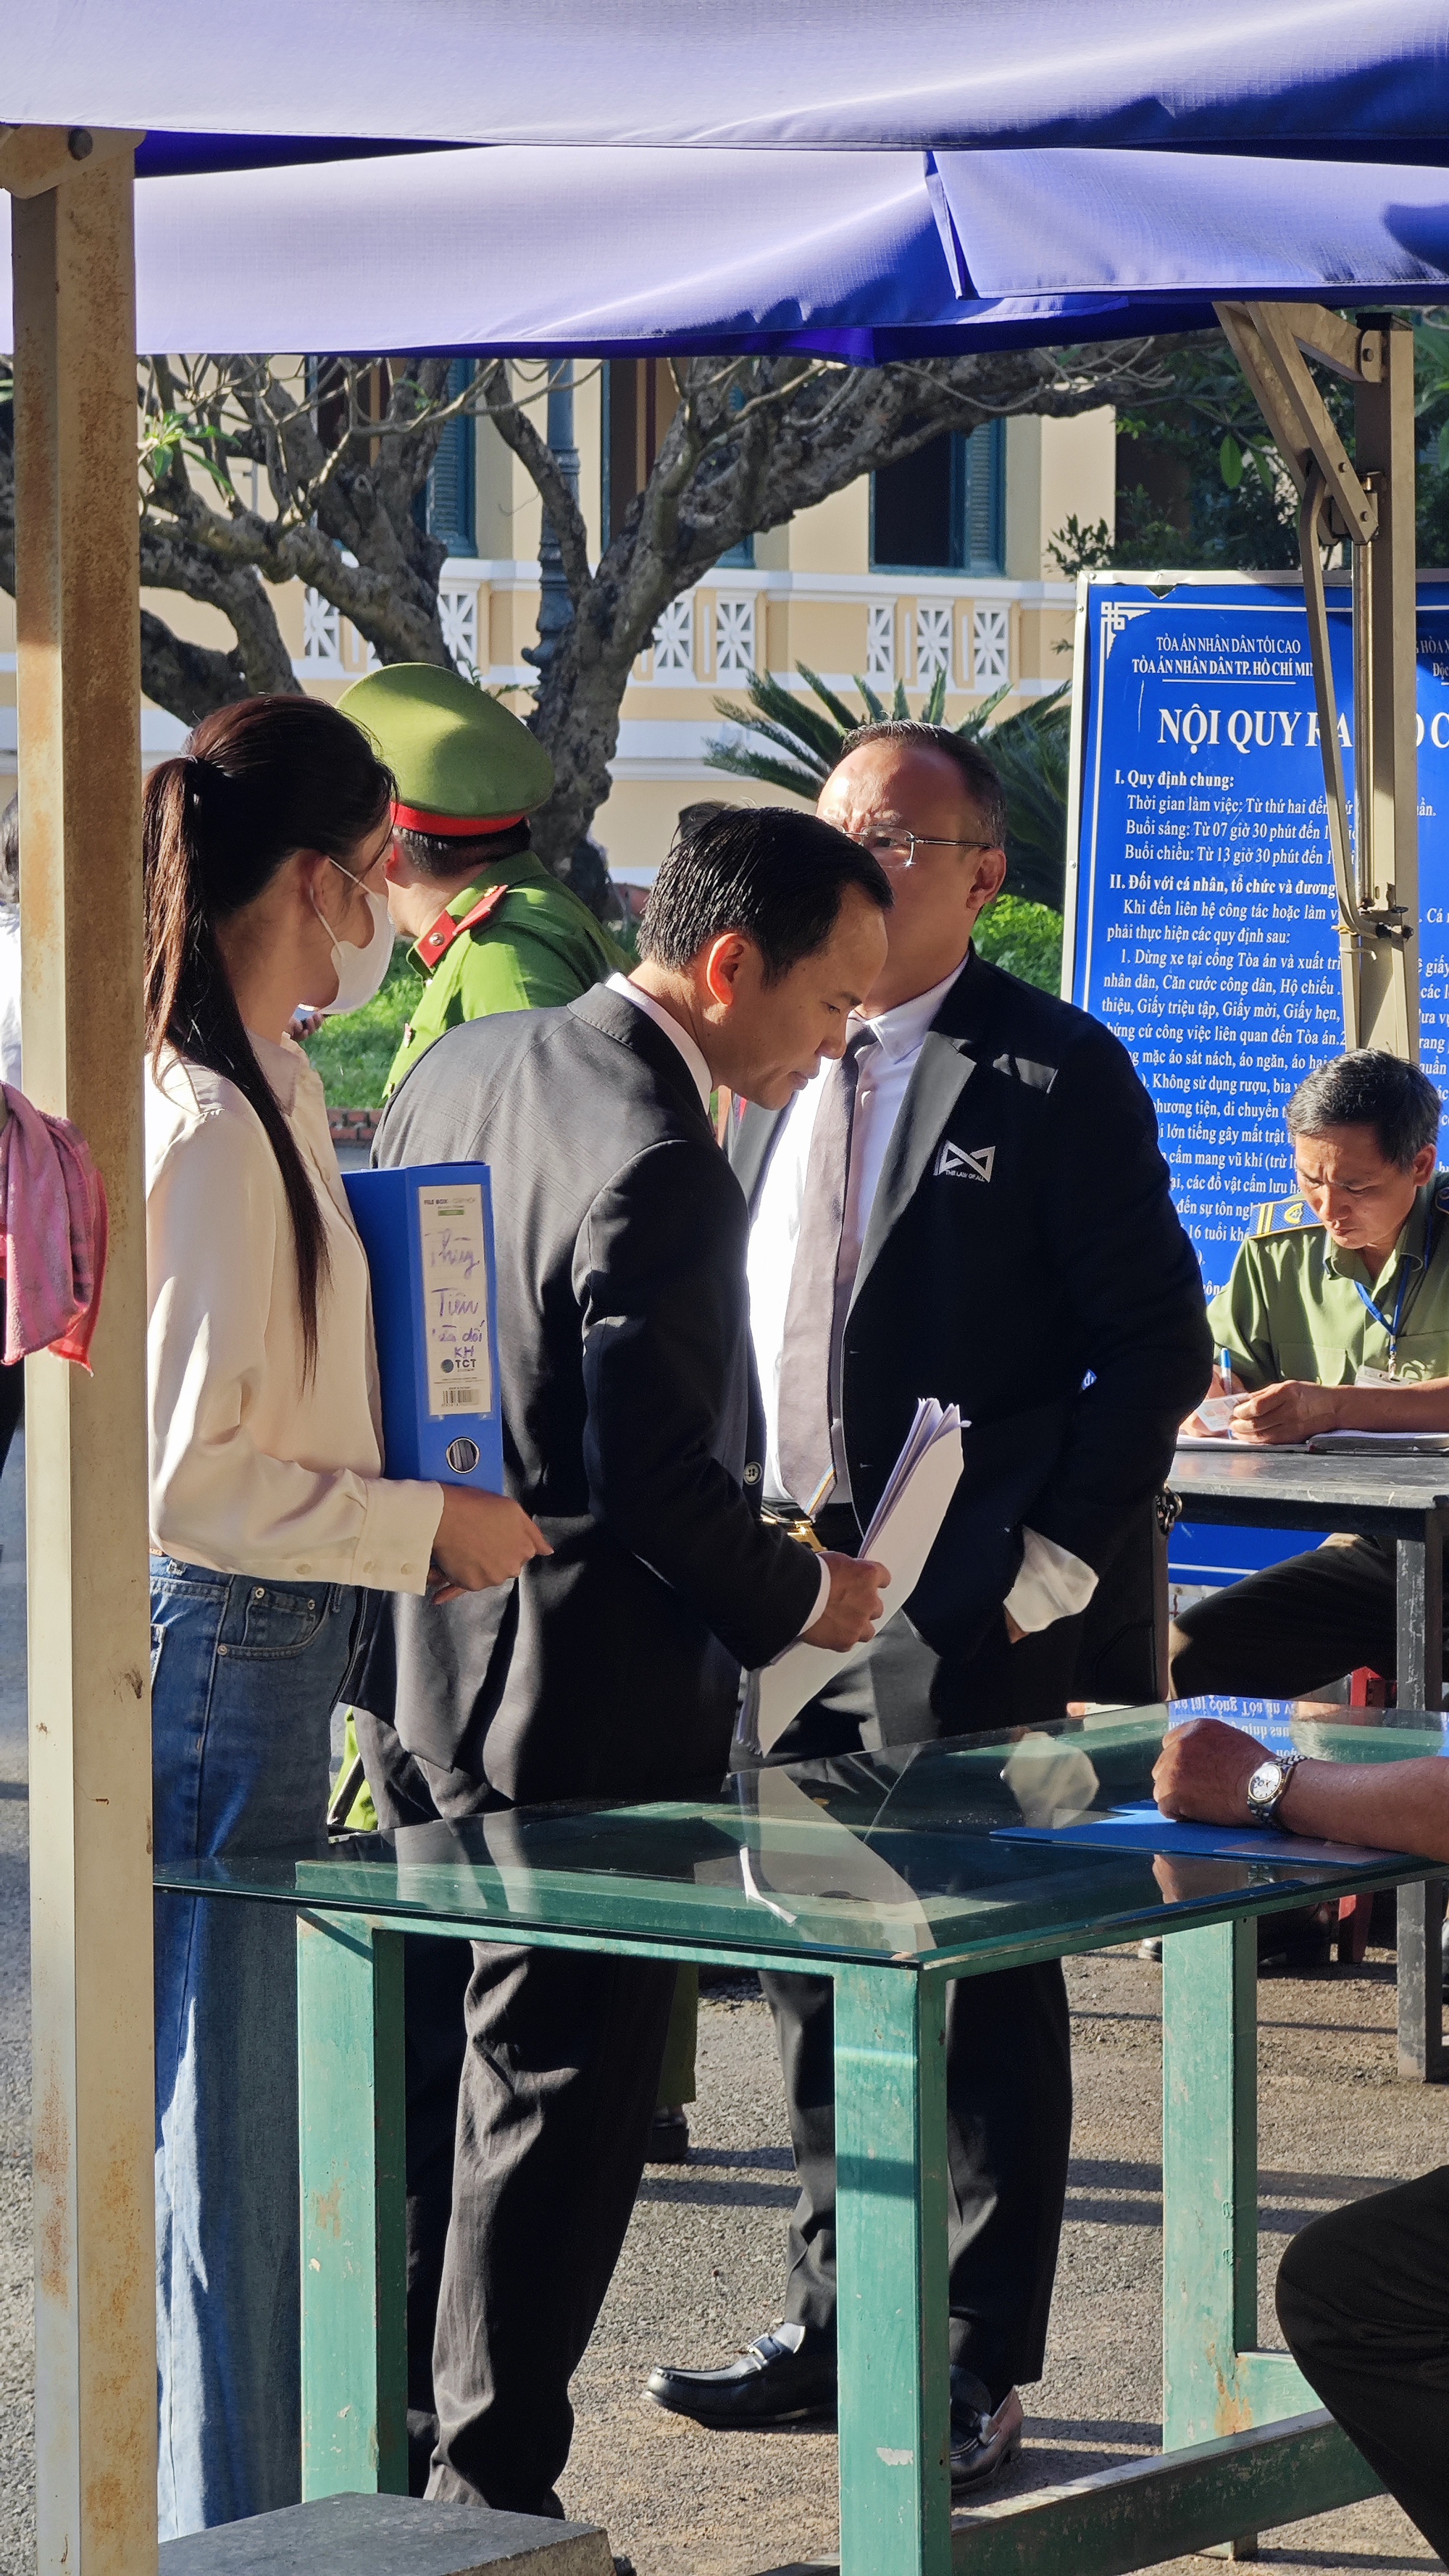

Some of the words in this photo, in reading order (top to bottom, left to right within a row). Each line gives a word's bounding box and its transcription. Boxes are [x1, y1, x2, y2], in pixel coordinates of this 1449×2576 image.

[1156, 633, 1181, 651] TÒA
[1181, 633, 1195, 652] ÁN
[1198, 634, 1229, 652] NHÂN
[1232, 635, 1255, 653] DÂN
[1256, 635, 1274, 653] TỐI
[1277, 639, 1300, 654] CAO
[1132, 654, 1158, 674] TÒA
[1158, 655, 1173, 674] ÁN
[1175, 656, 1207, 674] NHÂN
[1209, 656, 1233, 674] DÂN
[1235, 661, 1251, 675] TP.
[1253, 658, 1271, 675] HỒ
[1272, 658, 1293, 676] CHÍ
[1158, 703, 1222, 754] NỘI
[1228, 710, 1301, 754] QUY
[1115, 769, 1124, 785] I.
[1127, 770, 1155, 789] Quy
[1158, 771, 1187, 789] định
[1190, 771, 1234, 791] chung:
[1127, 795, 1156, 810] Thời
[1159, 795, 1185, 814] gian
[1188, 796, 1211, 811] làm
[1214, 798, 1243, 815] việc:
[1246, 798, 1263, 813] Từ
[1287, 799, 1306, 814] hai
[1126, 816, 1156, 835] Buổi
[1158, 821, 1190, 840] sáng:
[1193, 821, 1211, 837] Từ
[1213, 822, 1228, 837] 07
[1229, 822, 1250, 841] giờ
[1252, 823, 1267, 838] 30
[1269, 824, 1297, 842] phút
[1299, 820, 1320, 839] đến
[1125, 841, 1154, 859] Buổi
[1157, 841, 1194, 861] chiều:
[1197, 846, 1214, 861] Từ
[1218, 847, 1230, 862] 13
[1233, 847, 1253, 866] giờ
[1256, 848, 1271, 863] 30
[1272, 848, 1300, 867] phút
[1302, 845, 1323, 864] đến
[1110, 874, 1125, 889] II.
[1129, 871, 1151, 890] Đối
[1154, 876, 1174, 890] với
[1177, 877, 1190, 891] cá
[1193, 877, 1228, 895] nhân,
[1232, 874, 1243, 892] tổ
[1245, 879, 1275, 893] chức
[1279, 879, 1293, 894] và
[1295, 880, 1336, 898] đương
[1124, 899, 1146, 914] Khi
[1150, 896, 1171, 915] đến
[1175, 900, 1198, 916] liên
[1201, 901, 1215, 919] hệ
[1219, 902, 1248, 921] công
[1251, 903, 1269, 918] tác
[1272, 903, 1300, 921] hoặc
[1304, 904, 1326, 920] làm
[1427, 908, 1443, 923] Cá
[1107, 924, 1133, 942] phải
[1136, 924, 1162, 942] thực
[1164, 925, 1189, 943] hiện
[1192, 927, 1211, 941] các
[1214, 930, 1236, 946] quy
[1238, 927, 1264, 945] định
[1266, 932, 1290, 944] sau:
[1122, 949, 1131, 963] 1.
[1135, 949, 1167, 968] Dừng
[1170, 953, 1185, 963] xe
[1187, 950, 1203, 969] tại
[1206, 948, 1235, 971] cổng
[1237, 952, 1259, 967] Tòa
[1263, 953, 1277, 968] án
[1280, 953, 1294, 969] và
[1298, 950, 1324, 969] xuất
[1103, 972, 1131, 987] nhân
[1135, 974, 1159, 991] dân,
[1163, 974, 1185, 990] Căn
[1189, 976, 1217, 991] cước
[1220, 977, 1249, 995] công
[1252, 977, 1277, 996] dân,
[1280, 979, 1298, 996] Hộ
[1301, 976, 1334, 995] chiếu
[1421, 983, 1441, 999] các
[1102, 997, 1135, 1015] thiệu,
[1137, 995, 1166, 1018] Giấy
[1168, 999, 1195, 1017] triệu
[1198, 1000, 1219, 1019] tập,
[1222, 998, 1251, 1021] Giấy
[1253, 1002, 1281, 1020] mời,
[1284, 1000, 1313, 1023] Giấy
[1315, 1005, 1340, 1022] hẹn,
[1138, 1023, 1153, 1038] cứ
[1156, 1024, 1184, 1043] công
[1187, 1024, 1211, 1043] việc
[1214, 1026, 1237, 1041] liên
[1240, 1030, 1268, 1045] quan
[1271, 1024, 1293, 1043] đến
[1296, 1029, 1319, 1044] Tòa
[1143, 1050, 1166, 1066] mặc
[1169, 1049, 1182, 1064] áo
[1186, 1050, 1203, 1064] sát
[1206, 1050, 1236, 1069] nách,
[1240, 1052, 1253, 1066] áo
[1292, 1054, 1305, 1069] áo
[1153, 1074, 1191, 1092] Không
[1193, 1075, 1207, 1090] sử
[1209, 1075, 1237, 1095] dụng
[1240, 1080, 1271, 1095] rượu,
[1273, 1077, 1291, 1094] bia
[1195, 1100, 1221, 1118] tiện,
[1224, 1101, 1235, 1116] di
[1238, 1099, 1279, 1121] chuyển
[1167, 1124, 1185, 1139] lớn
[1188, 1121, 1216, 1144] tiếng
[1219, 1126, 1239, 1145] gây
[1242, 1123, 1262, 1142] mất
[1265, 1128, 1285, 1147] trật
[1169, 1145, 1192, 1164] cấm
[1195, 1153, 1226, 1169] mang
[1228, 1153, 1242, 1166] vũ
[1245, 1152, 1263, 1168] khí
[1187, 1175, 1205, 1189] các
[1208, 1171, 1222, 1190] đồ
[1224, 1176, 1242, 1195] vật
[1243, 1174, 1266, 1192] cấm
[1269, 1178, 1287, 1194] lưu
[1177, 1195, 1197, 1214] đến
[1200, 1203, 1213, 1218] sự
[1216, 1202, 1233, 1216] tôn
[1205, 1222, 1227, 1241] tuổi
[454, 1345, 475, 1358] KH
[455, 1358, 476, 1368] TCT
